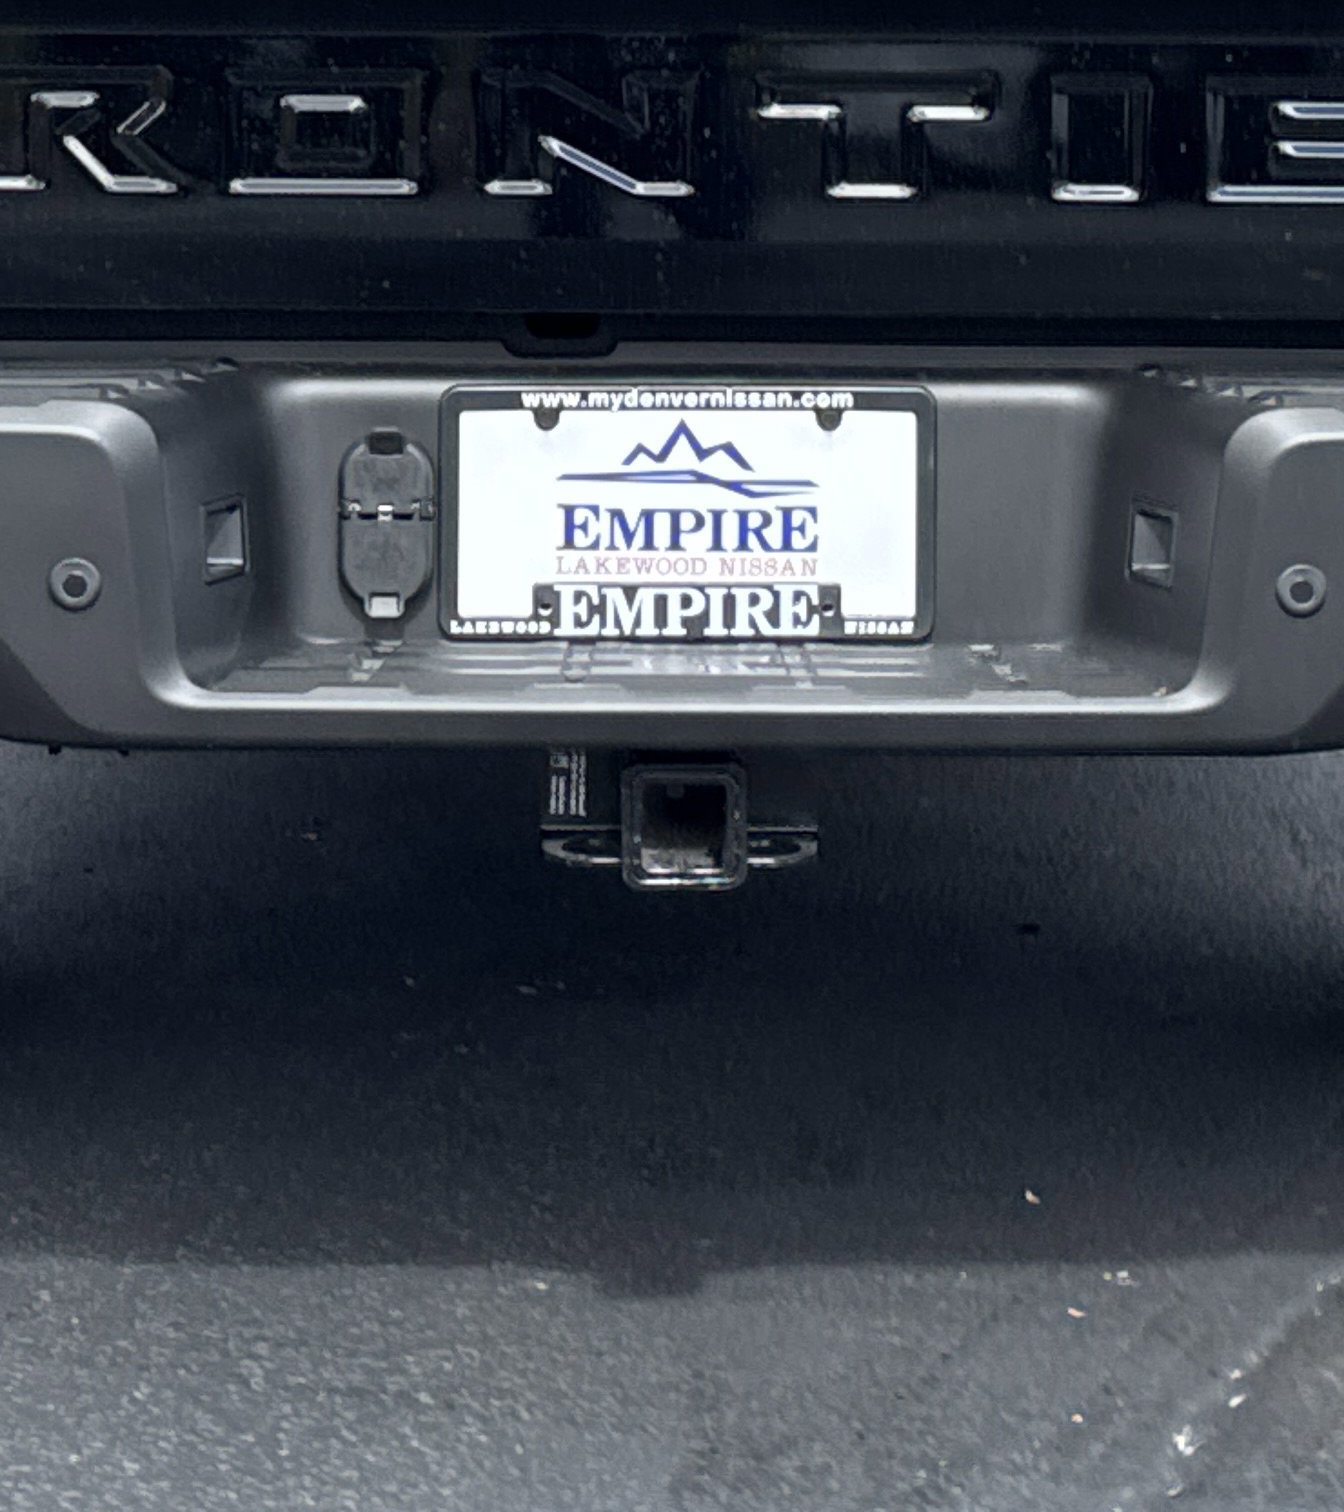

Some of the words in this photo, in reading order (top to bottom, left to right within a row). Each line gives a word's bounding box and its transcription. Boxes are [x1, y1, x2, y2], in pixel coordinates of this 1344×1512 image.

[520, 390, 854, 412] www.mydenvernissan.com
[556, 503, 819, 553] EMPIRE
[556, 556, 707, 576] LAKEWOOD
[719, 557, 818, 577] NISSAN
[554, 584, 820, 637] EMPIRE
